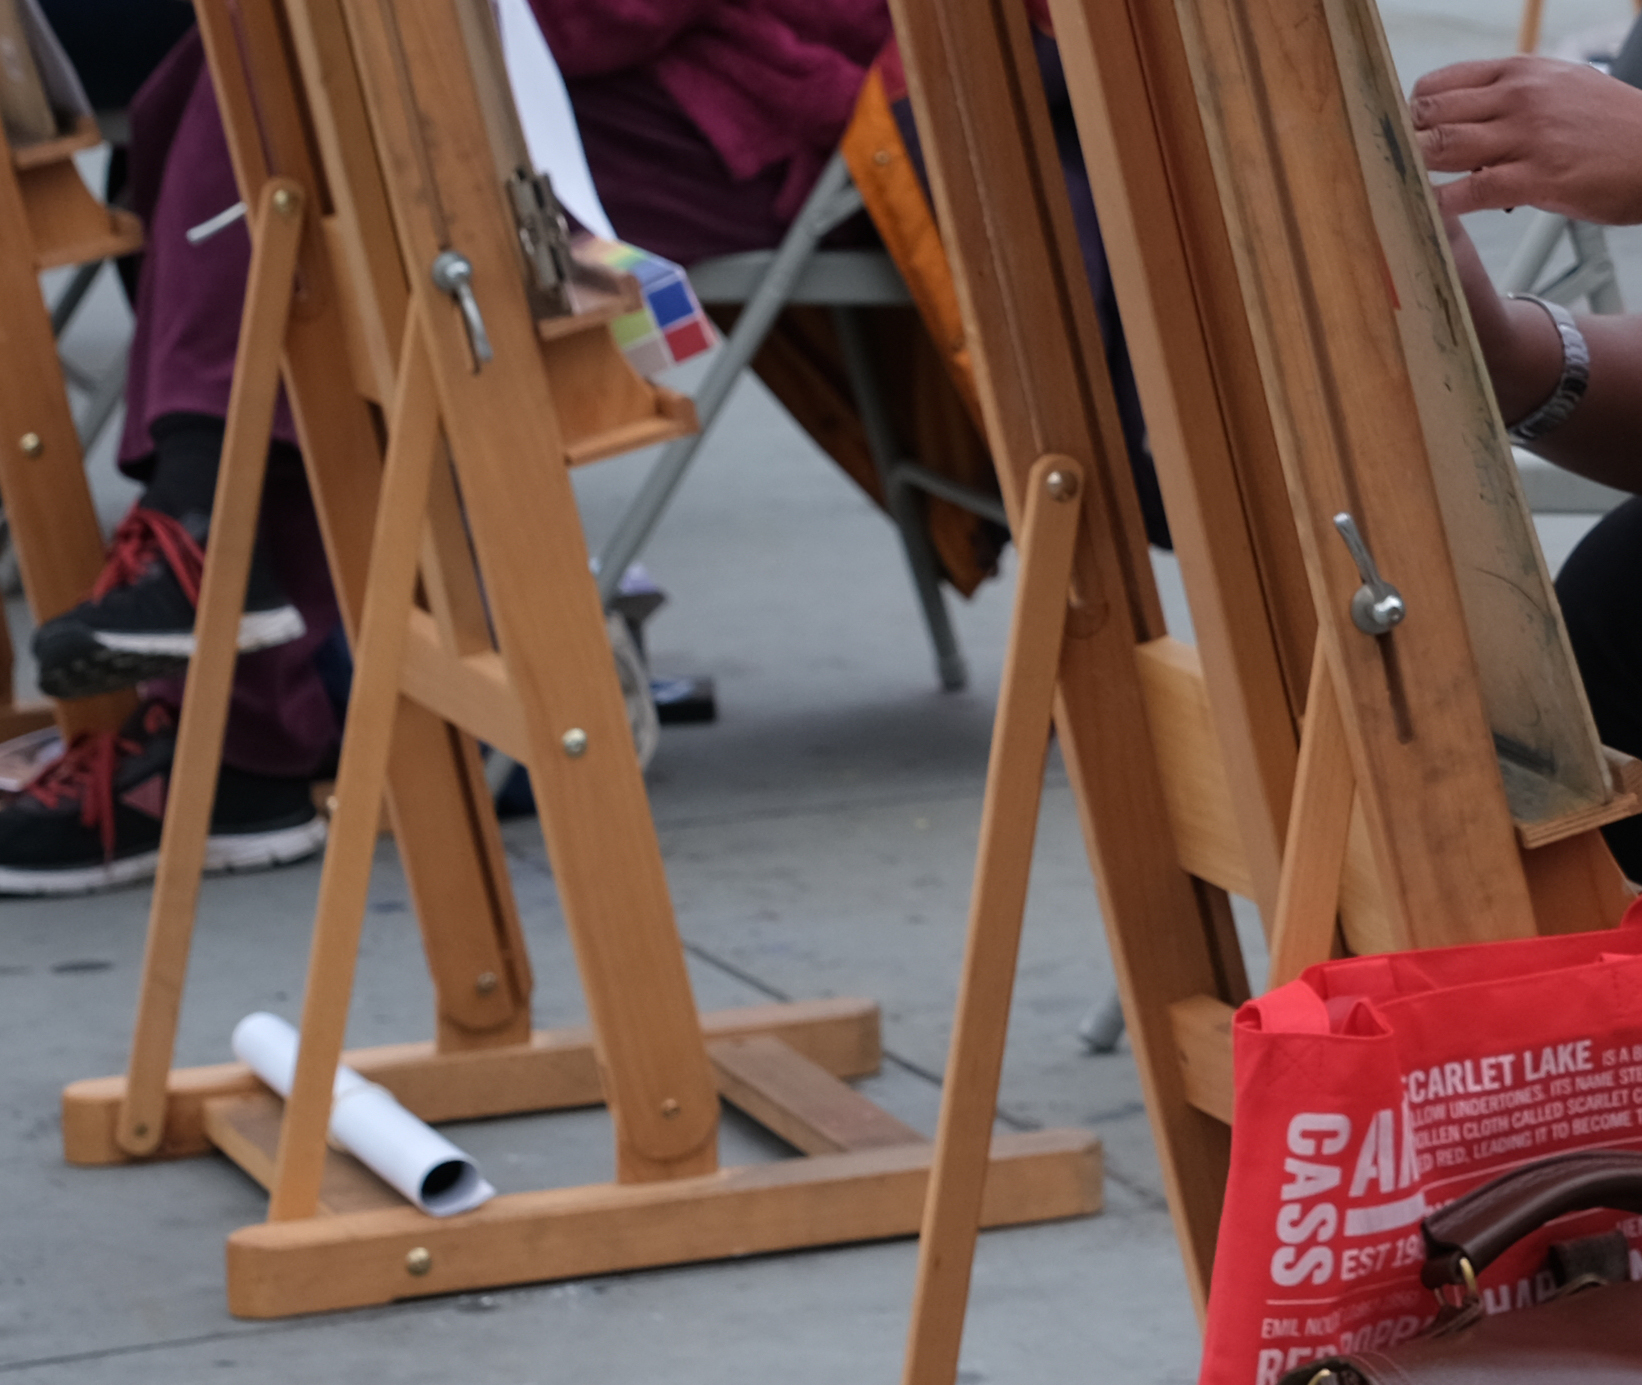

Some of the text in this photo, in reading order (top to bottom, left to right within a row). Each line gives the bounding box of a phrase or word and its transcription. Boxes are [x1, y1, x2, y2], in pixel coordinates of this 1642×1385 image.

[1523, 1038, 1594, 1082] LAKE
[1602, 1048, 1617, 1066] IS
[1550, 1076, 1572, 1097] ITS
[1575, 1069, 1614, 1092] NAME
[1463, 1116, 1510, 1140] CLOTH
[1511, 1101, 1564, 1129] CALLED
[1566, 1088, 1629, 1115] SCARLET
[1473, 1130, 1533, 1160] LEADING
[1535, 1127, 1548, 1145] IT
[1552, 1122, 1570, 1142] TO
[1572, 1108, 1632, 1136] BECOME
[1269, 1112, 1351, 1286] CASS
[1340, 1242, 1392, 1281] EST
[1261, 1317, 1302, 1339] EMIL
